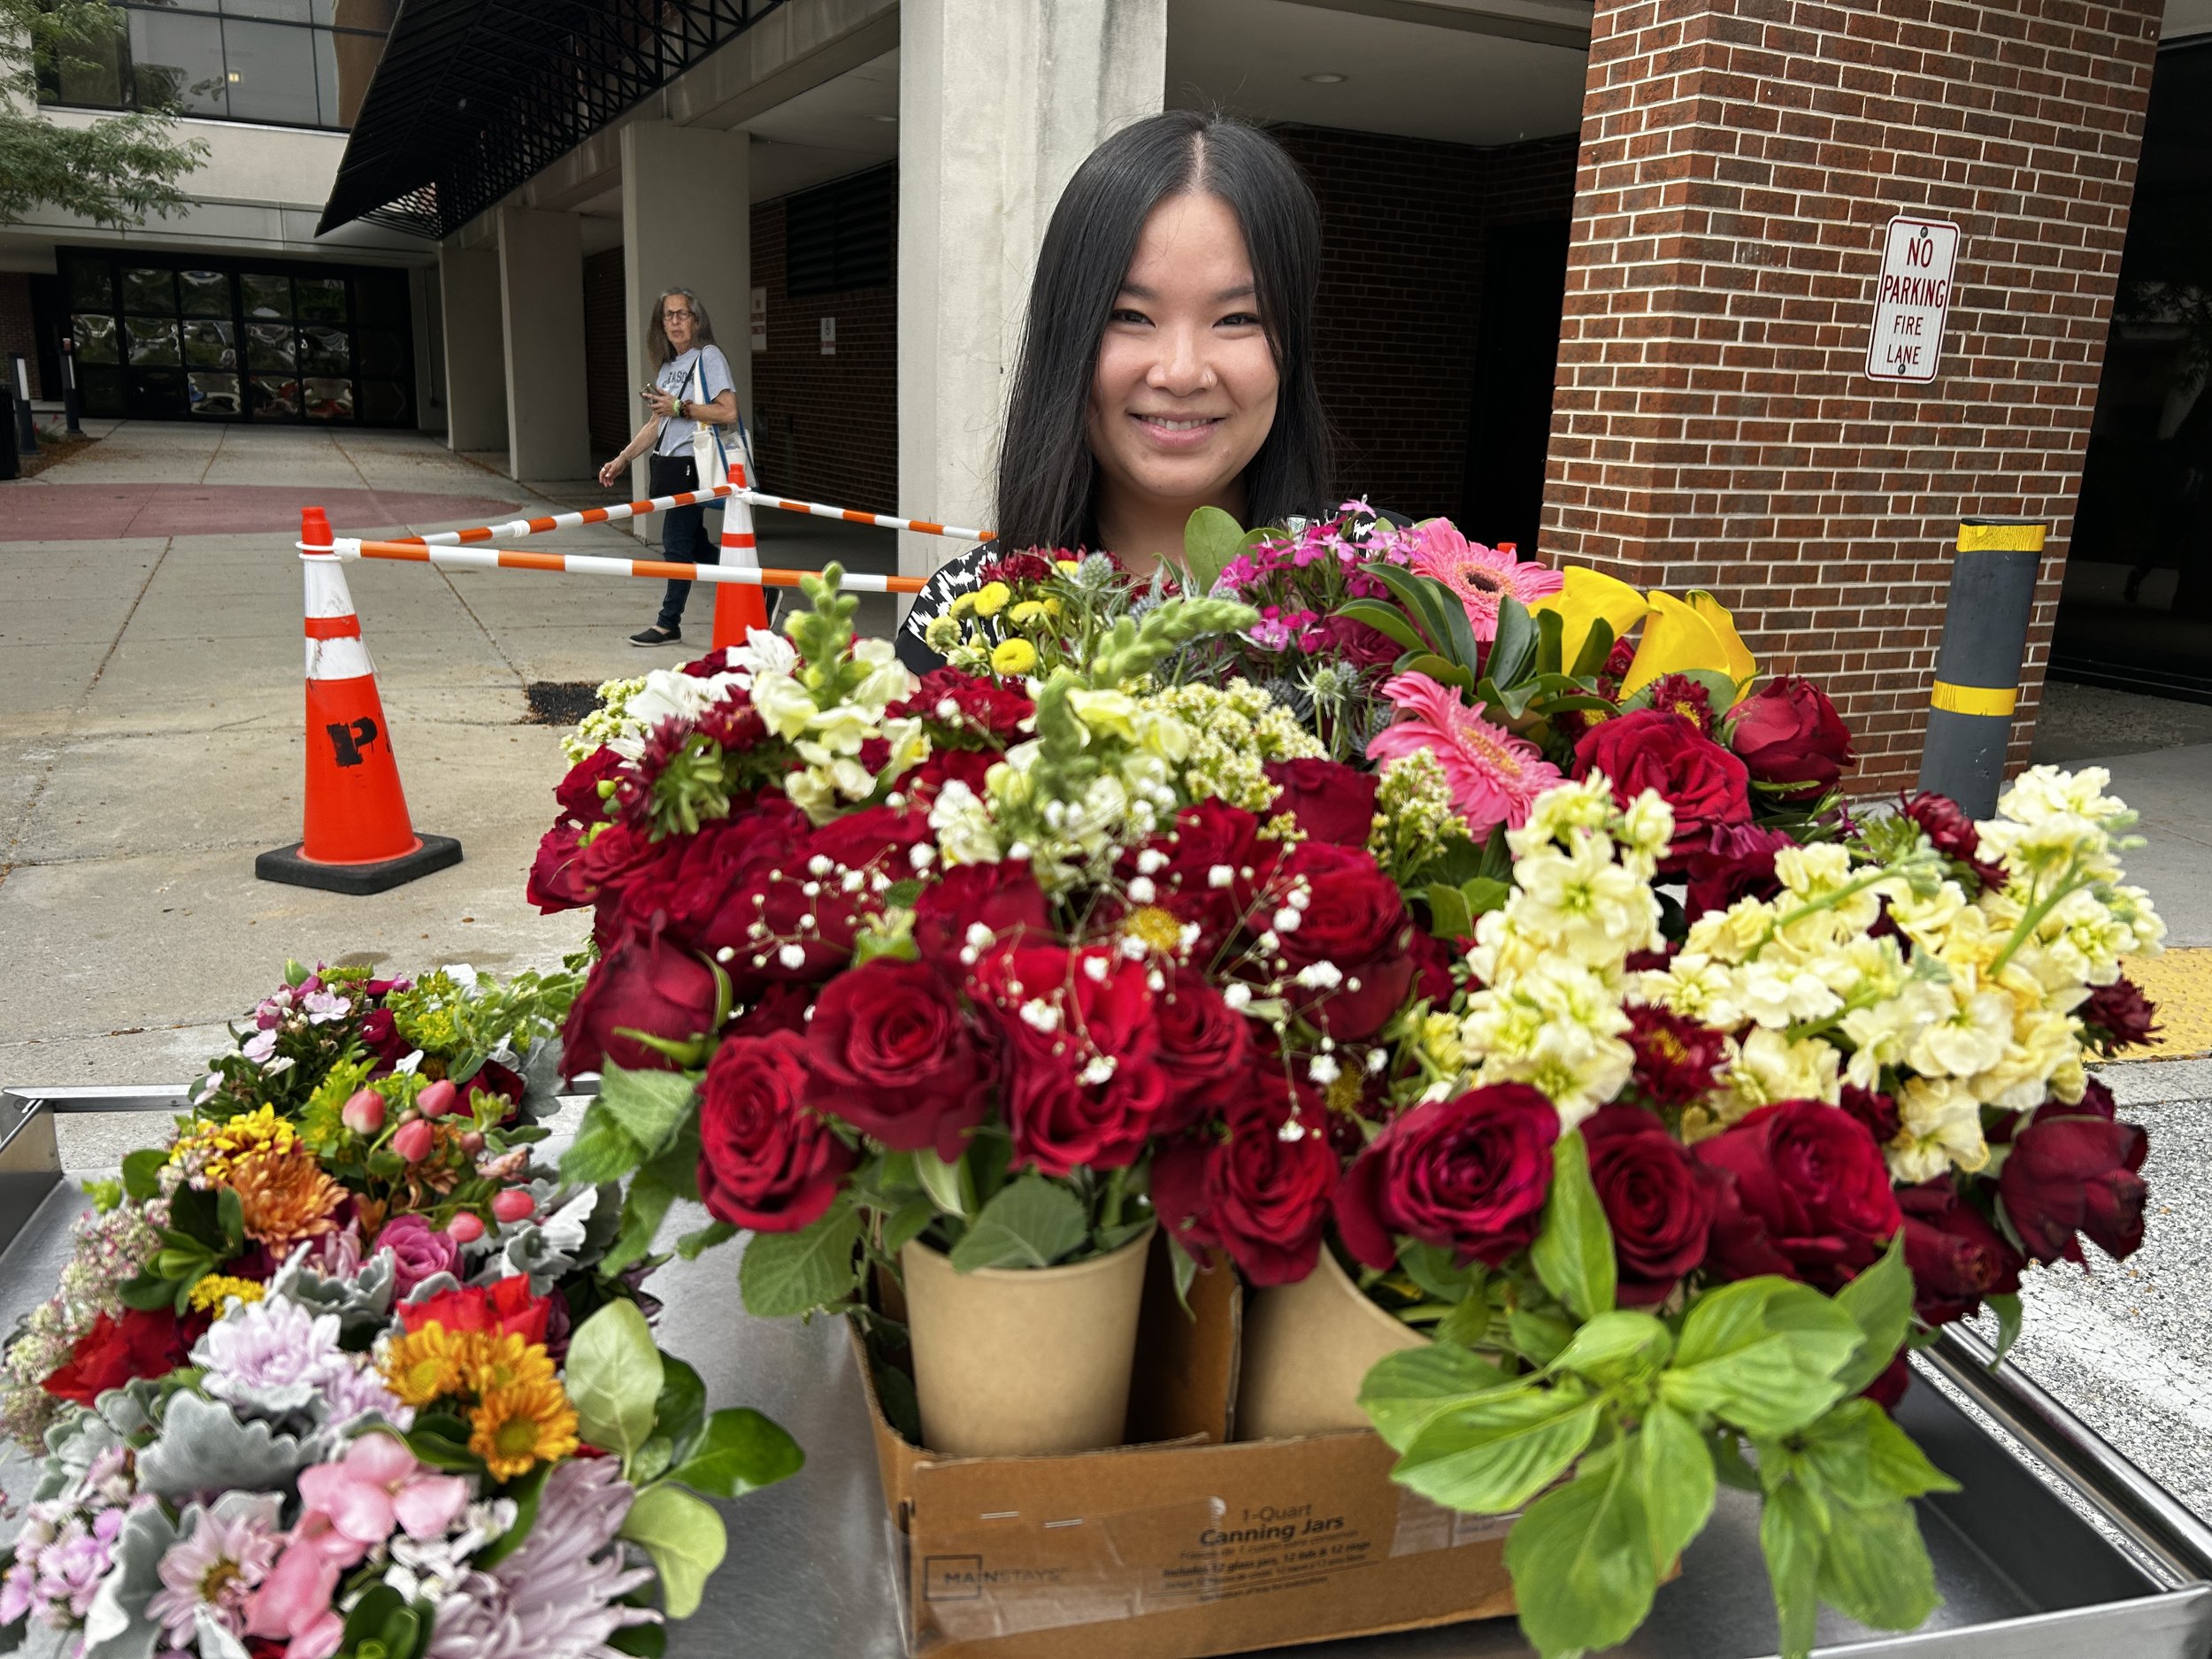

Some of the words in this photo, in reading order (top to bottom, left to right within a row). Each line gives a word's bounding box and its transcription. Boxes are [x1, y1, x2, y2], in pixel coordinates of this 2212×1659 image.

[1907, 237, 1933, 268] NO
[1882, 274, 1947, 309] PARKING
[1893, 315, 1924, 336] FIRE
[1886, 344, 1921, 365] LANE
[326, 716, 378, 768] P
[1241, 1503, 1313, 1523] 1-Quart
[1200, 1523, 1296, 1547] Canning
[1302, 1516, 1345, 1536] Jars
